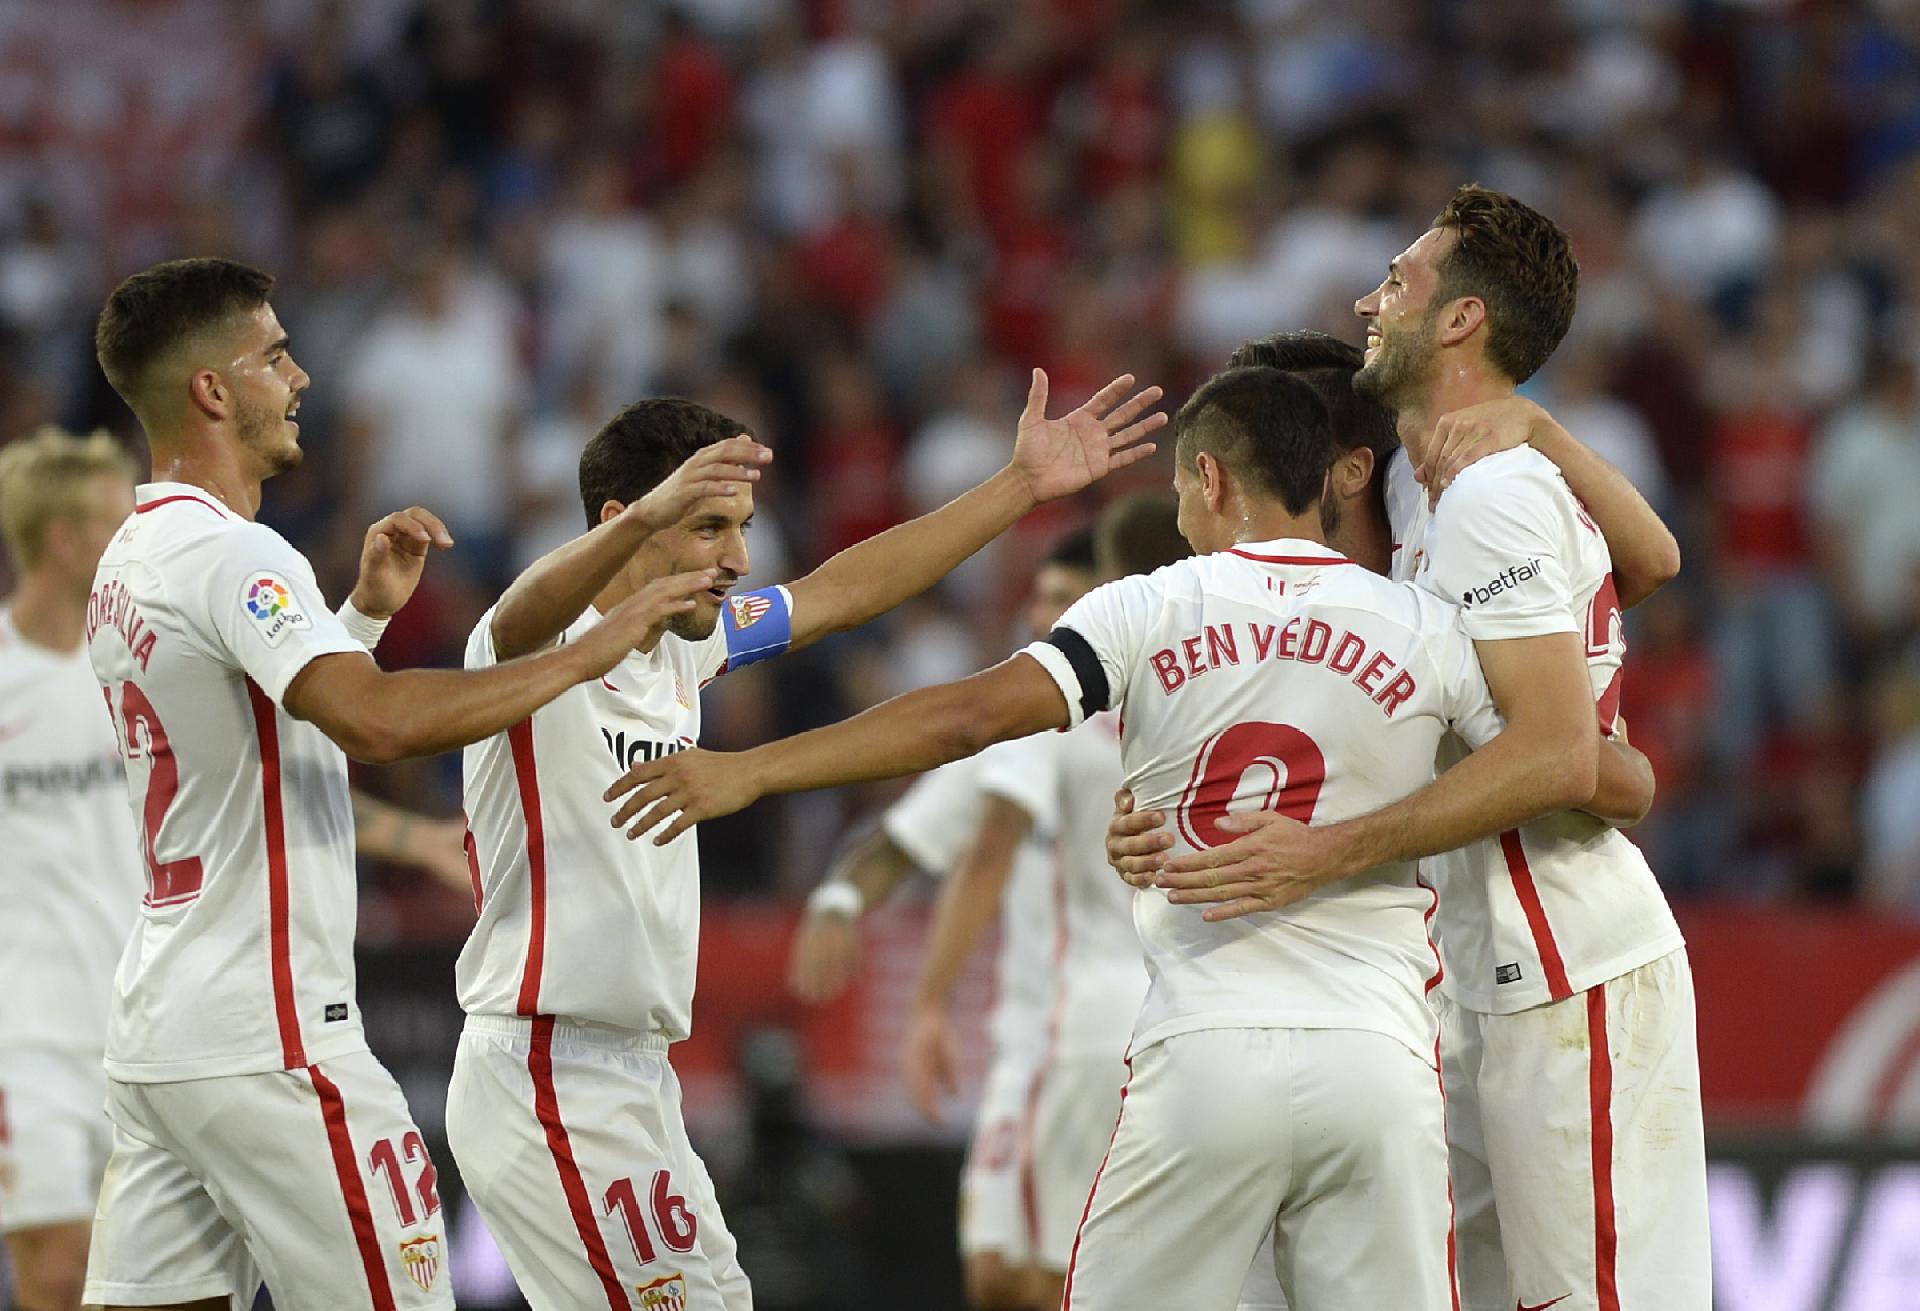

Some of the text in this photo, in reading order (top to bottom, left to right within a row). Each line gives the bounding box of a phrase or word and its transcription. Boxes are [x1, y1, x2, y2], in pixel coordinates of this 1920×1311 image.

[1472, 557, 1541, 605] betfair
[1149, 623, 1240, 696] BEN
[368, 1131, 441, 1228] 12
[602, 1169, 697, 1266] 16
